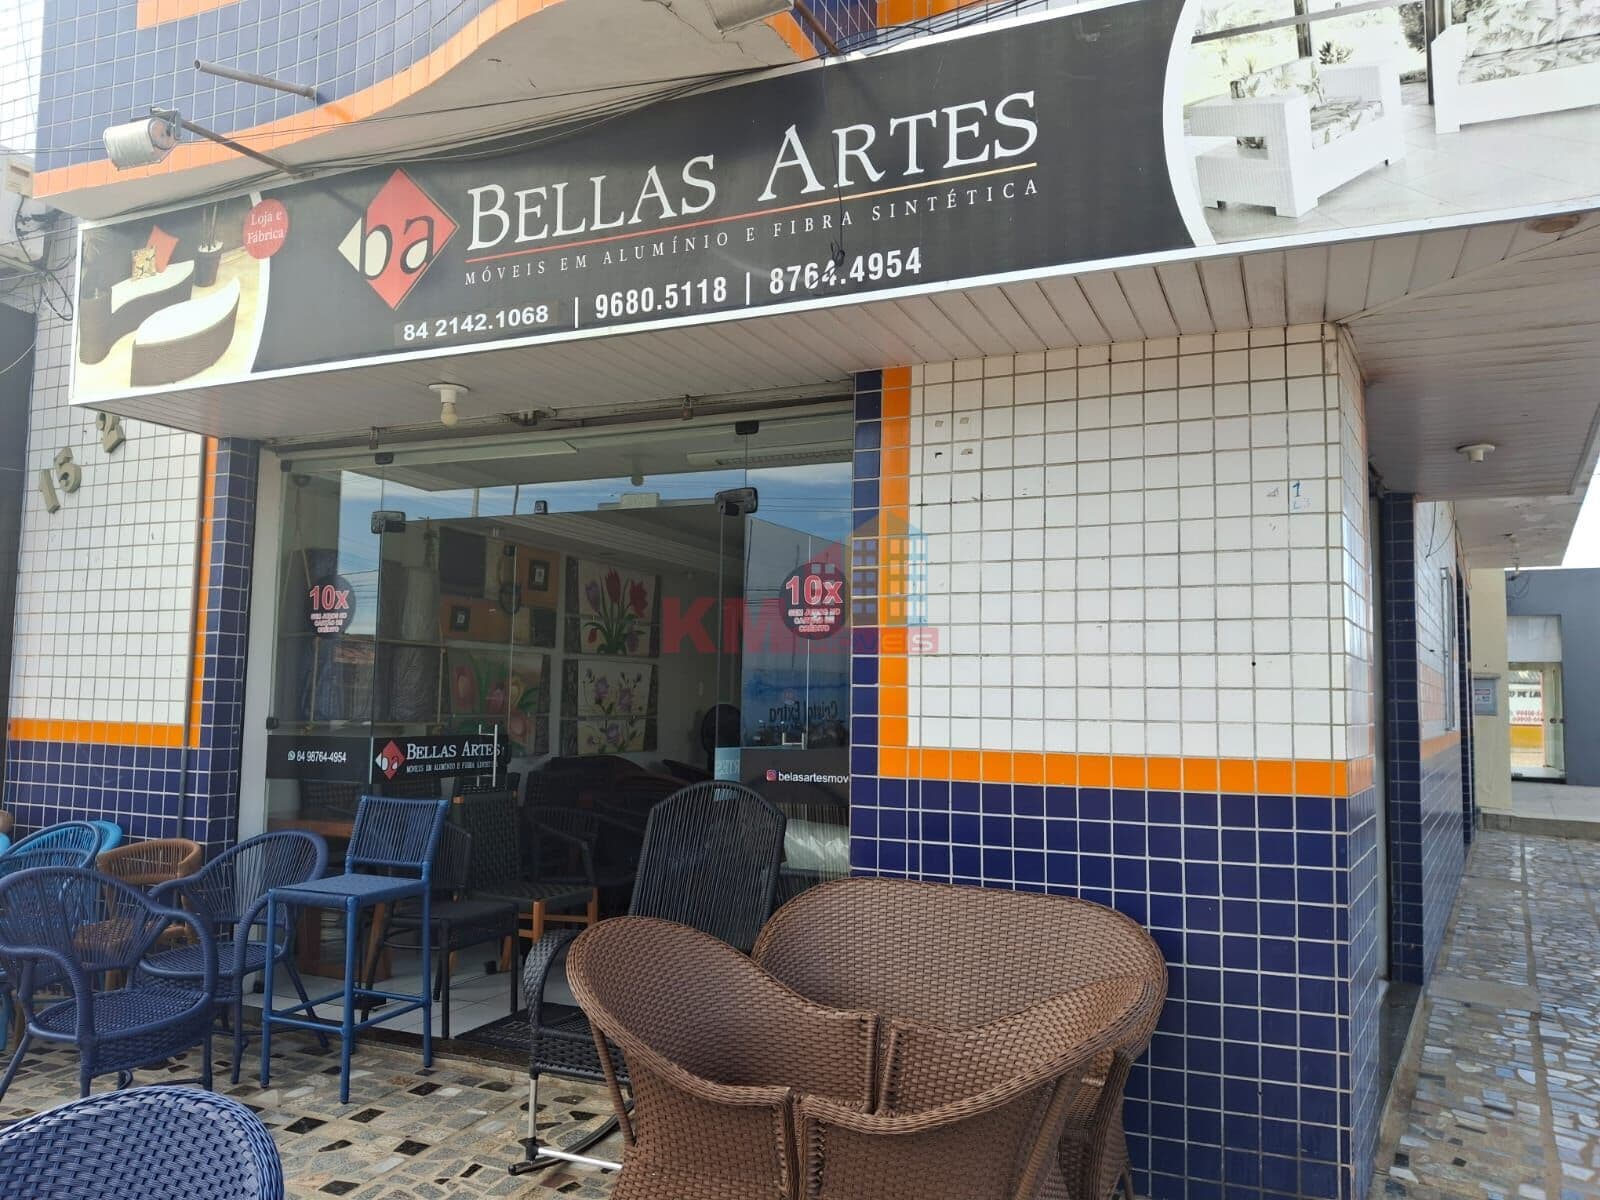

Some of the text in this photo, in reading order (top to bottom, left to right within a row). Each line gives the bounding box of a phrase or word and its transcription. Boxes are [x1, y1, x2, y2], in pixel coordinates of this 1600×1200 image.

[466, 90, 1038, 251] BELLAS ARTES
[250, 211, 283, 227] Loja e
[247, 227, 285, 245] Fábrica
[465, 178, 1038, 286] MÓVEIS EM ALUMÍNIO E FIBRA SINTÉTICA
[403, 247, 922, 341] 84 2142.1068 9680.5118 8764.4954
[296, 751, 347, 763] 84 98764-4954
[406, 743, 457, 761] BELLAS
